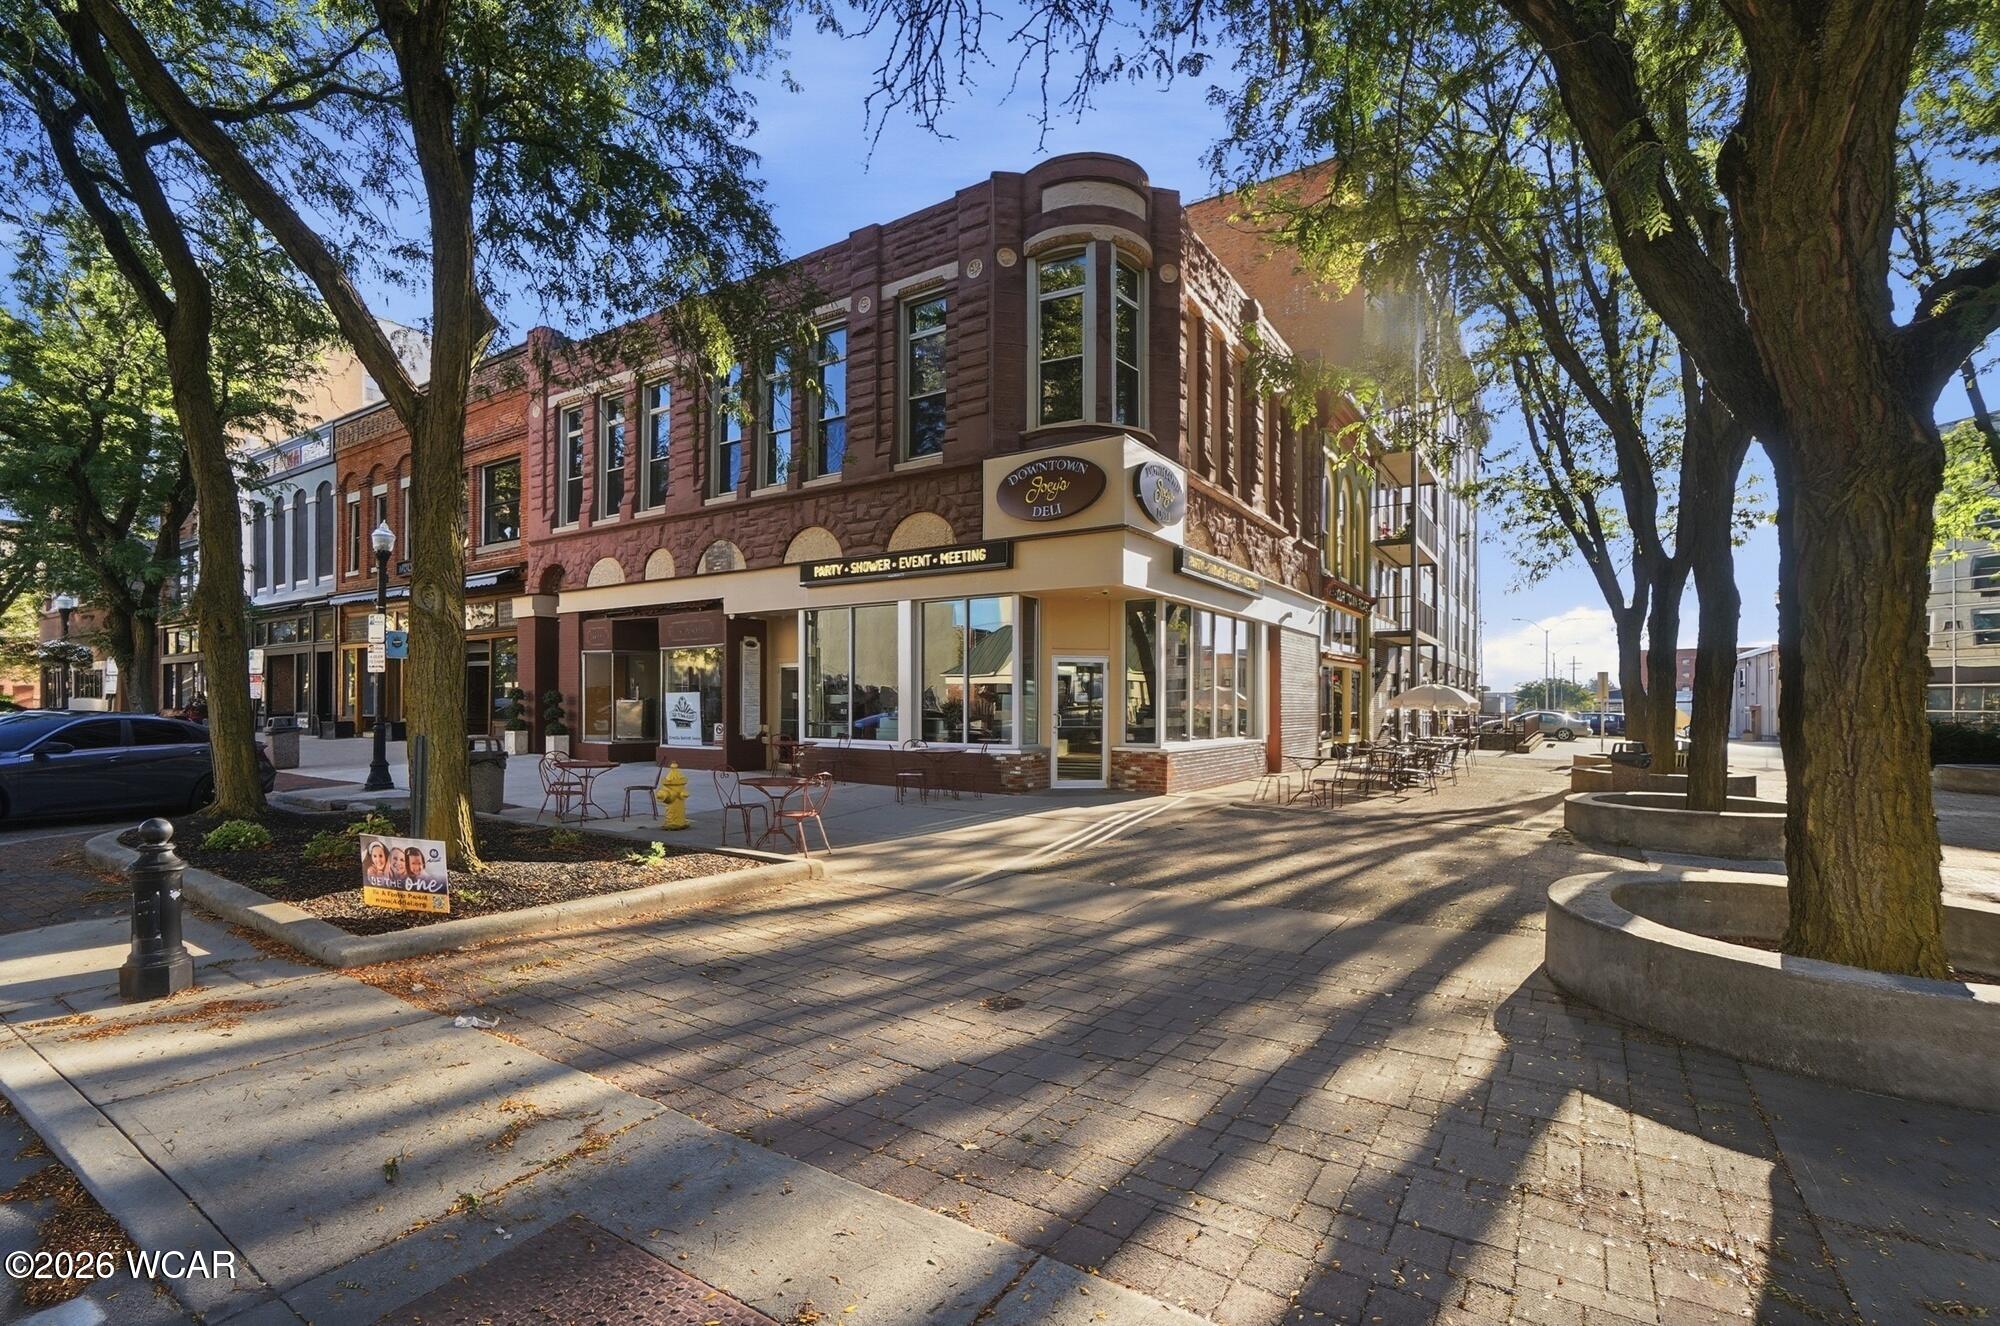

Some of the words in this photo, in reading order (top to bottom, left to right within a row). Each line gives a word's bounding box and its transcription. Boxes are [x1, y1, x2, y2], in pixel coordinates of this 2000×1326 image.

[1008, 459, 1089, 486] DOWNTOWN
[1025, 476, 1071, 504] Joey's
[1032, 503, 1062, 517] DELI
[813, 564, 843, 578] PARTY
[850, 559, 891, 574] SHOWER
[899, 554, 933, 569] EVENT
[940, 548, 987, 565] MEETING
[405, 877, 443, 893] one
